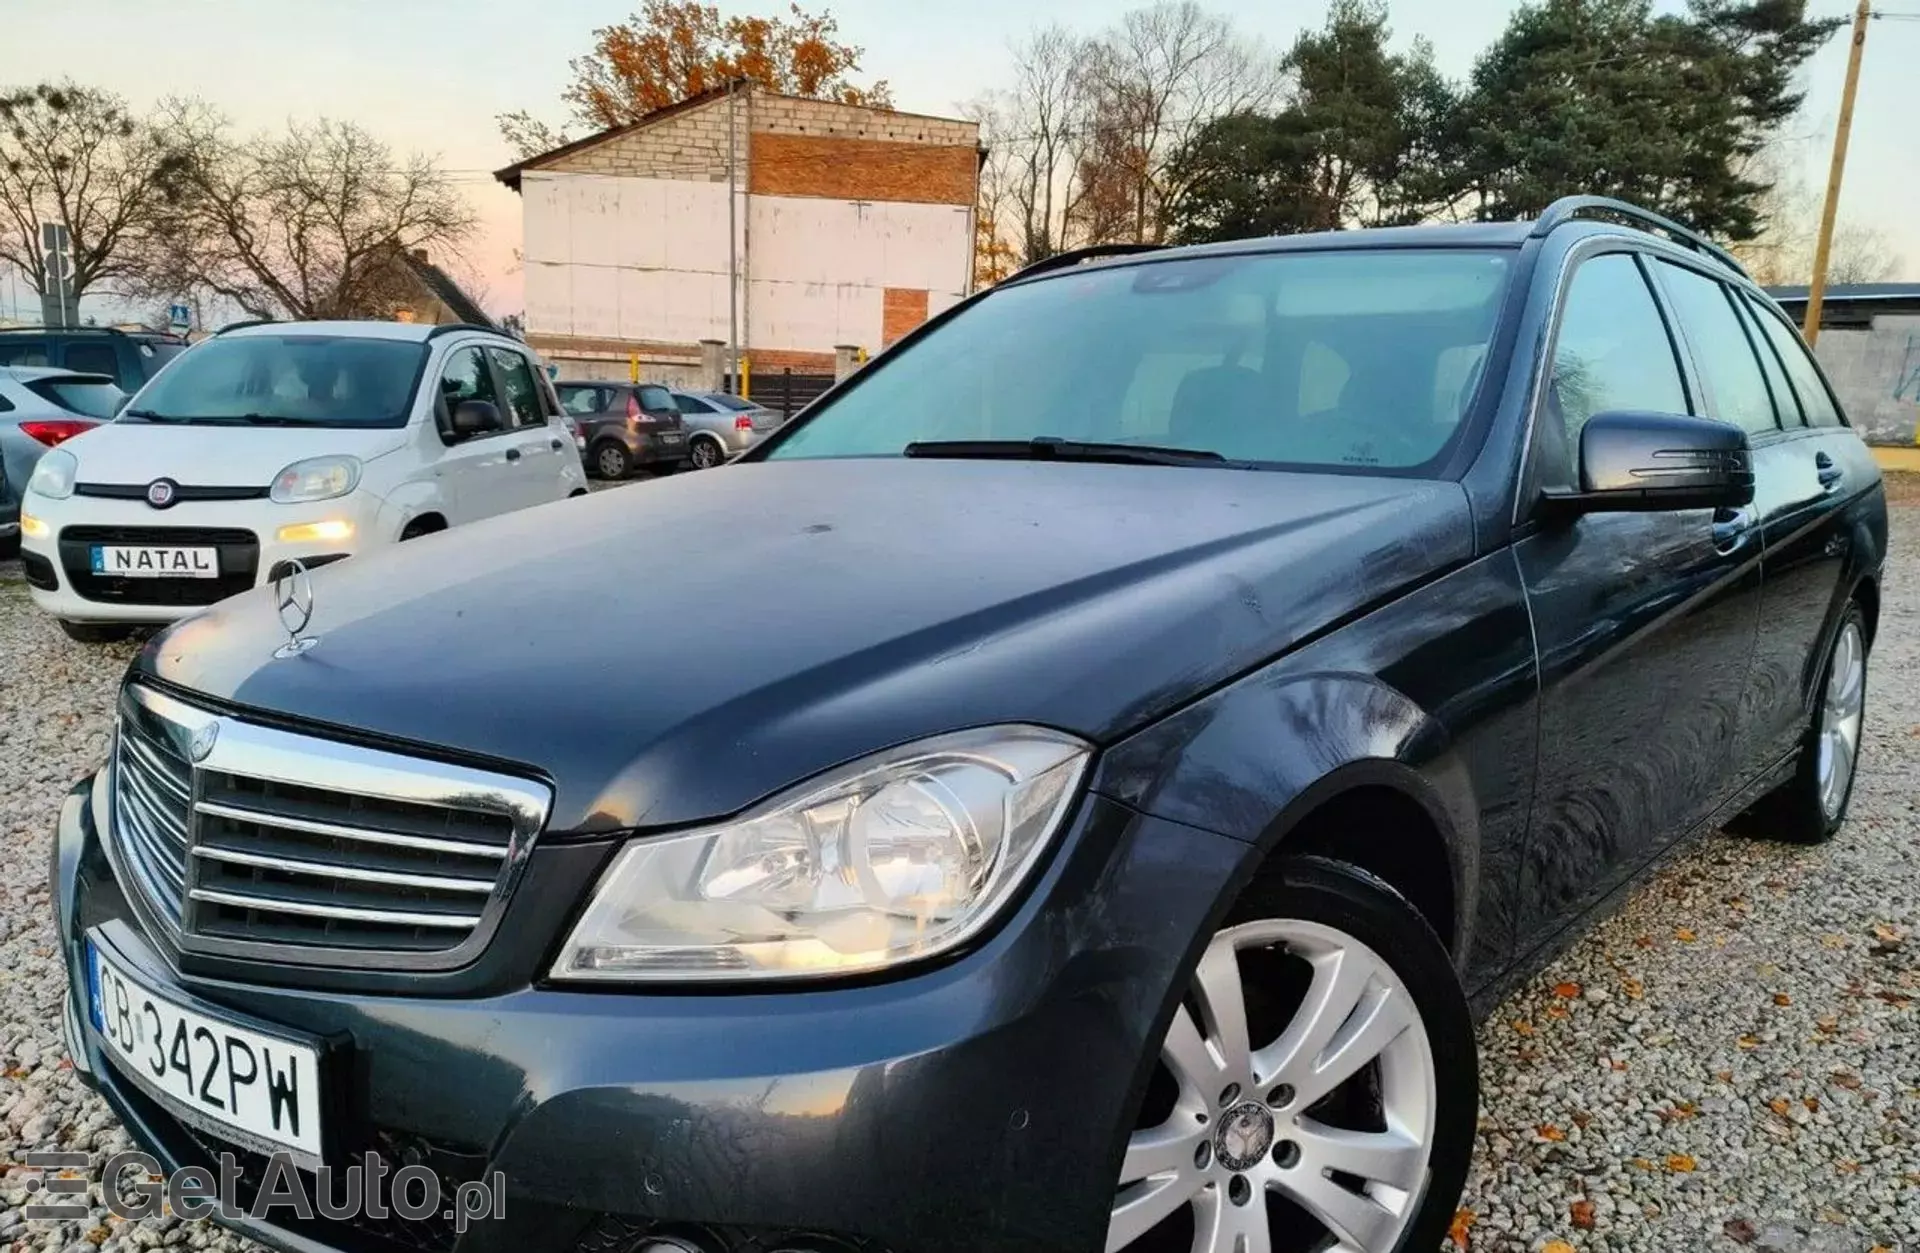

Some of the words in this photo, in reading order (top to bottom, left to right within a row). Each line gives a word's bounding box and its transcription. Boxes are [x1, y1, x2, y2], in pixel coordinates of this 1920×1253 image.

[116, 550, 209, 569] NATAL
[102, 965, 133, 1054] CB
[143, 1000, 300, 1137] 342PW
